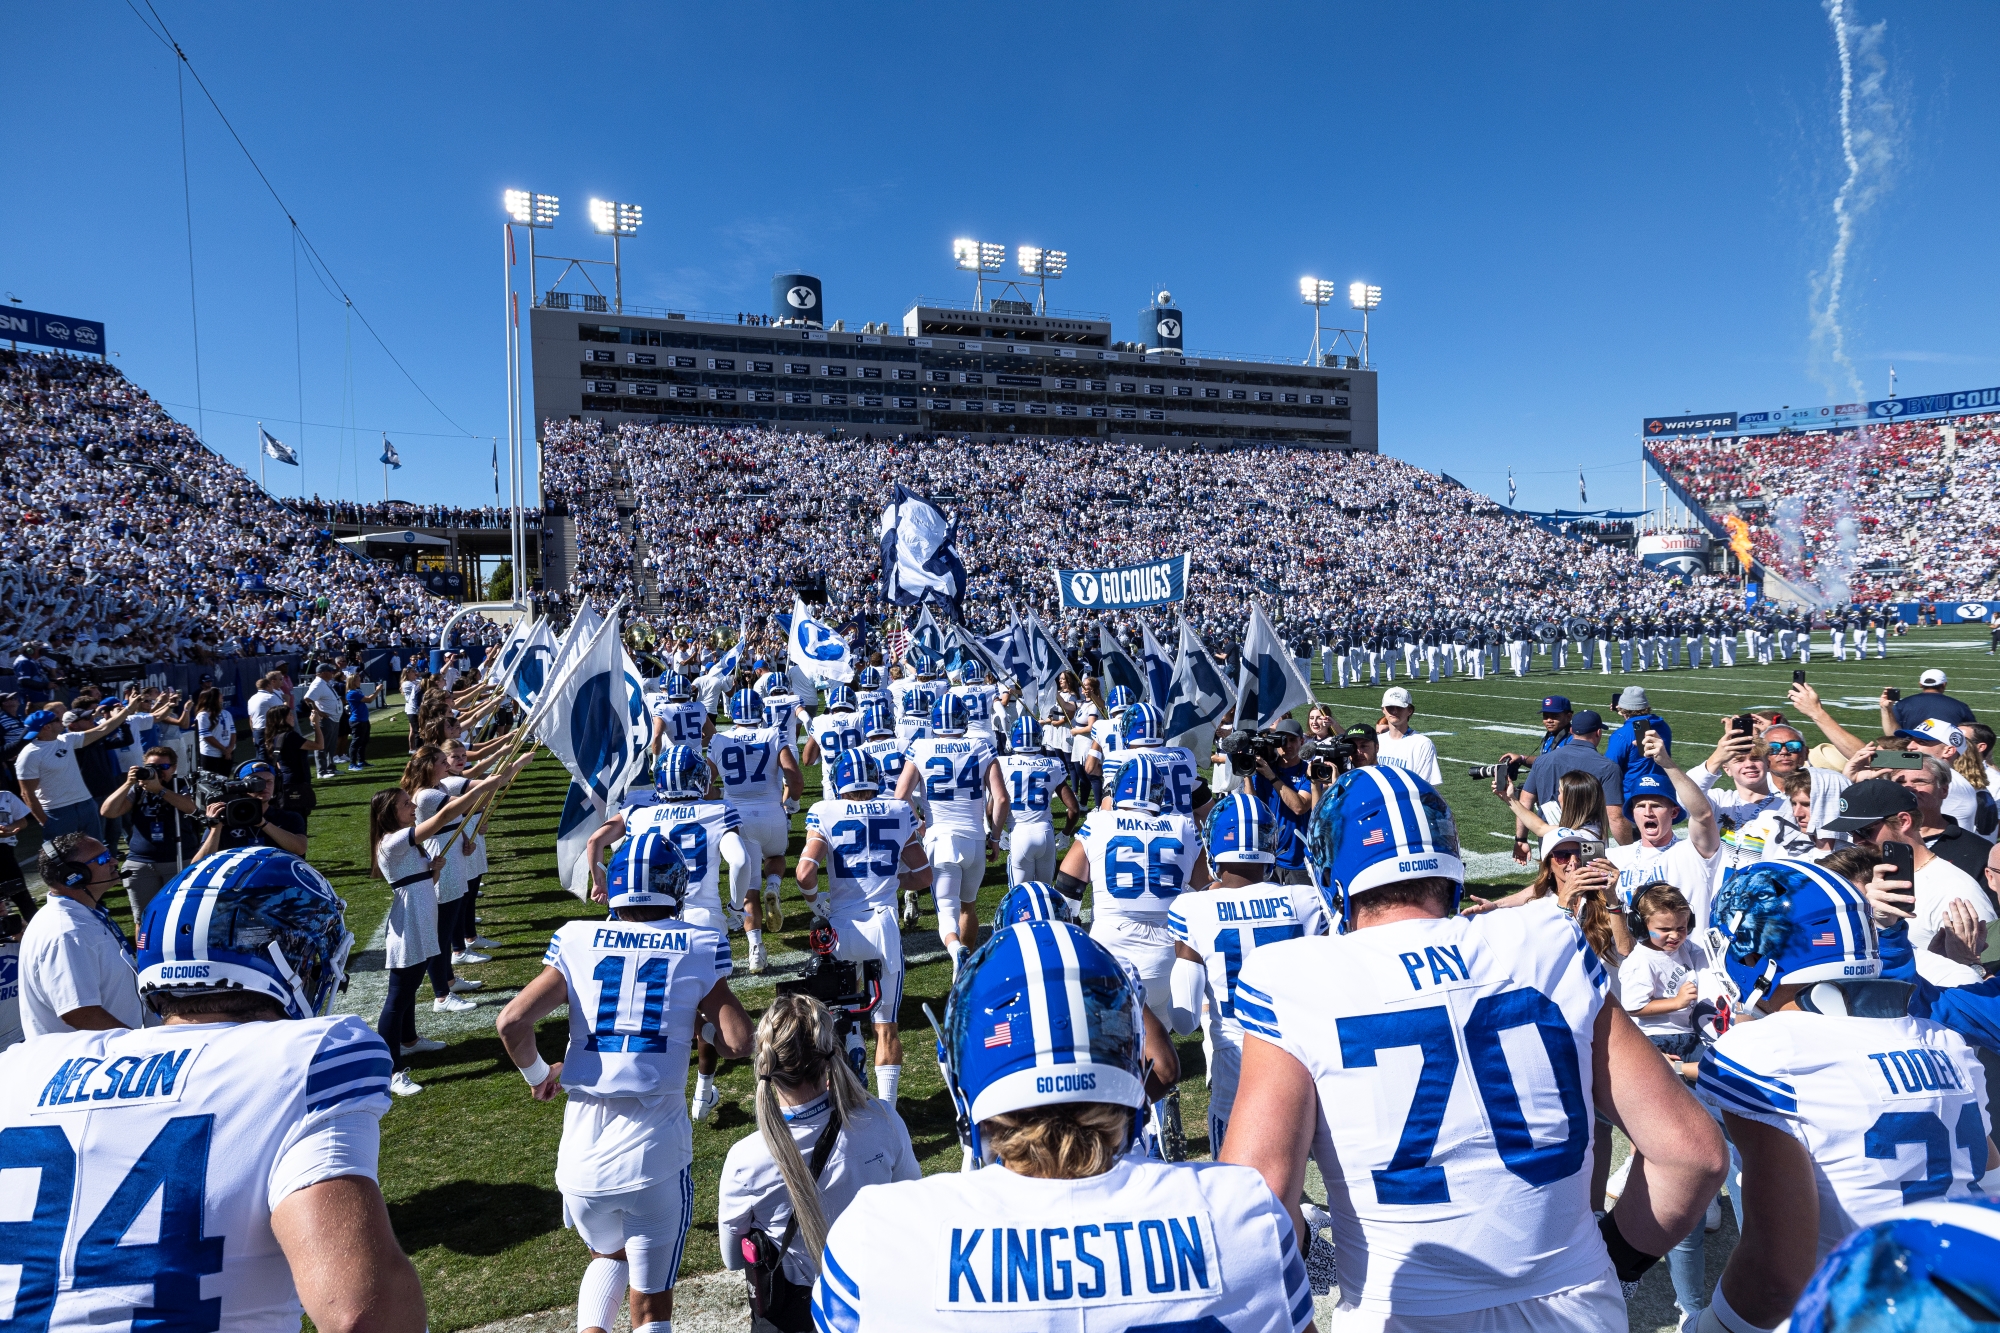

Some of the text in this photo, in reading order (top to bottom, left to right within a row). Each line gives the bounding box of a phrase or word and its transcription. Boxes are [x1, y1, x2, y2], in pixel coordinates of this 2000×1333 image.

[940, 313, 1092, 330] LAVELL EDWARDS STADIUM
[1907, 395, 1949, 414] BYU
[1952, 388, 2000, 409] COU
[1664, 418, 1732, 430] WAYSTAR
[1745, 414, 1764, 422] BYU
[1773, 412, 1781, 420] 0
[1821, 408, 1829, 416] 0
[1662, 537, 1702, 550] Smith's
[1100, 572, 1120, 604] GO
[1120, 563, 1171, 604] COUGS
[962, 693, 989, 720] 21
[673, 712, 702, 741] 15
[898, 718, 932, 727] CHRISTENS
[935, 742, 971, 754] REHKOW
[721, 742, 770, 785] 97
[1017, 758, 1053, 768] JACKSON
[1377, 756, 1407, 769] OOTBALL
[925, 755, 983, 801] 24
[1010, 771, 1051, 811] 16
[654, 806, 696, 822] BAMBA
[846, 803, 886, 816] ALFREY
[1117, 818, 1174, 832] MAKASINI
[646, 822, 707, 883] 9
[831, 818, 900, 878] 25
[1105, 835, 1184, 899] 66
[1398, 858, 1439, 873] GO COUGS
[1216, 896, 1292, 922] BILLOUPS
[593, 928, 687, 951] FENNEGAN
[161, 965, 210, 979] GO COUGS
[1399, 944, 1471, 991] PAY
[1843, 964, 1875, 976] GO COUGS
[584, 955, 670, 1053] 11
[37, 1048, 192, 1107] NELSON
[1036, 1073, 1096, 1094] GO COUGS
[1868, 1048, 1963, 1095] TOOLEY
[1335, 986, 1589, 1204] 70
[948, 1215, 1209, 1303] KINGSTON
